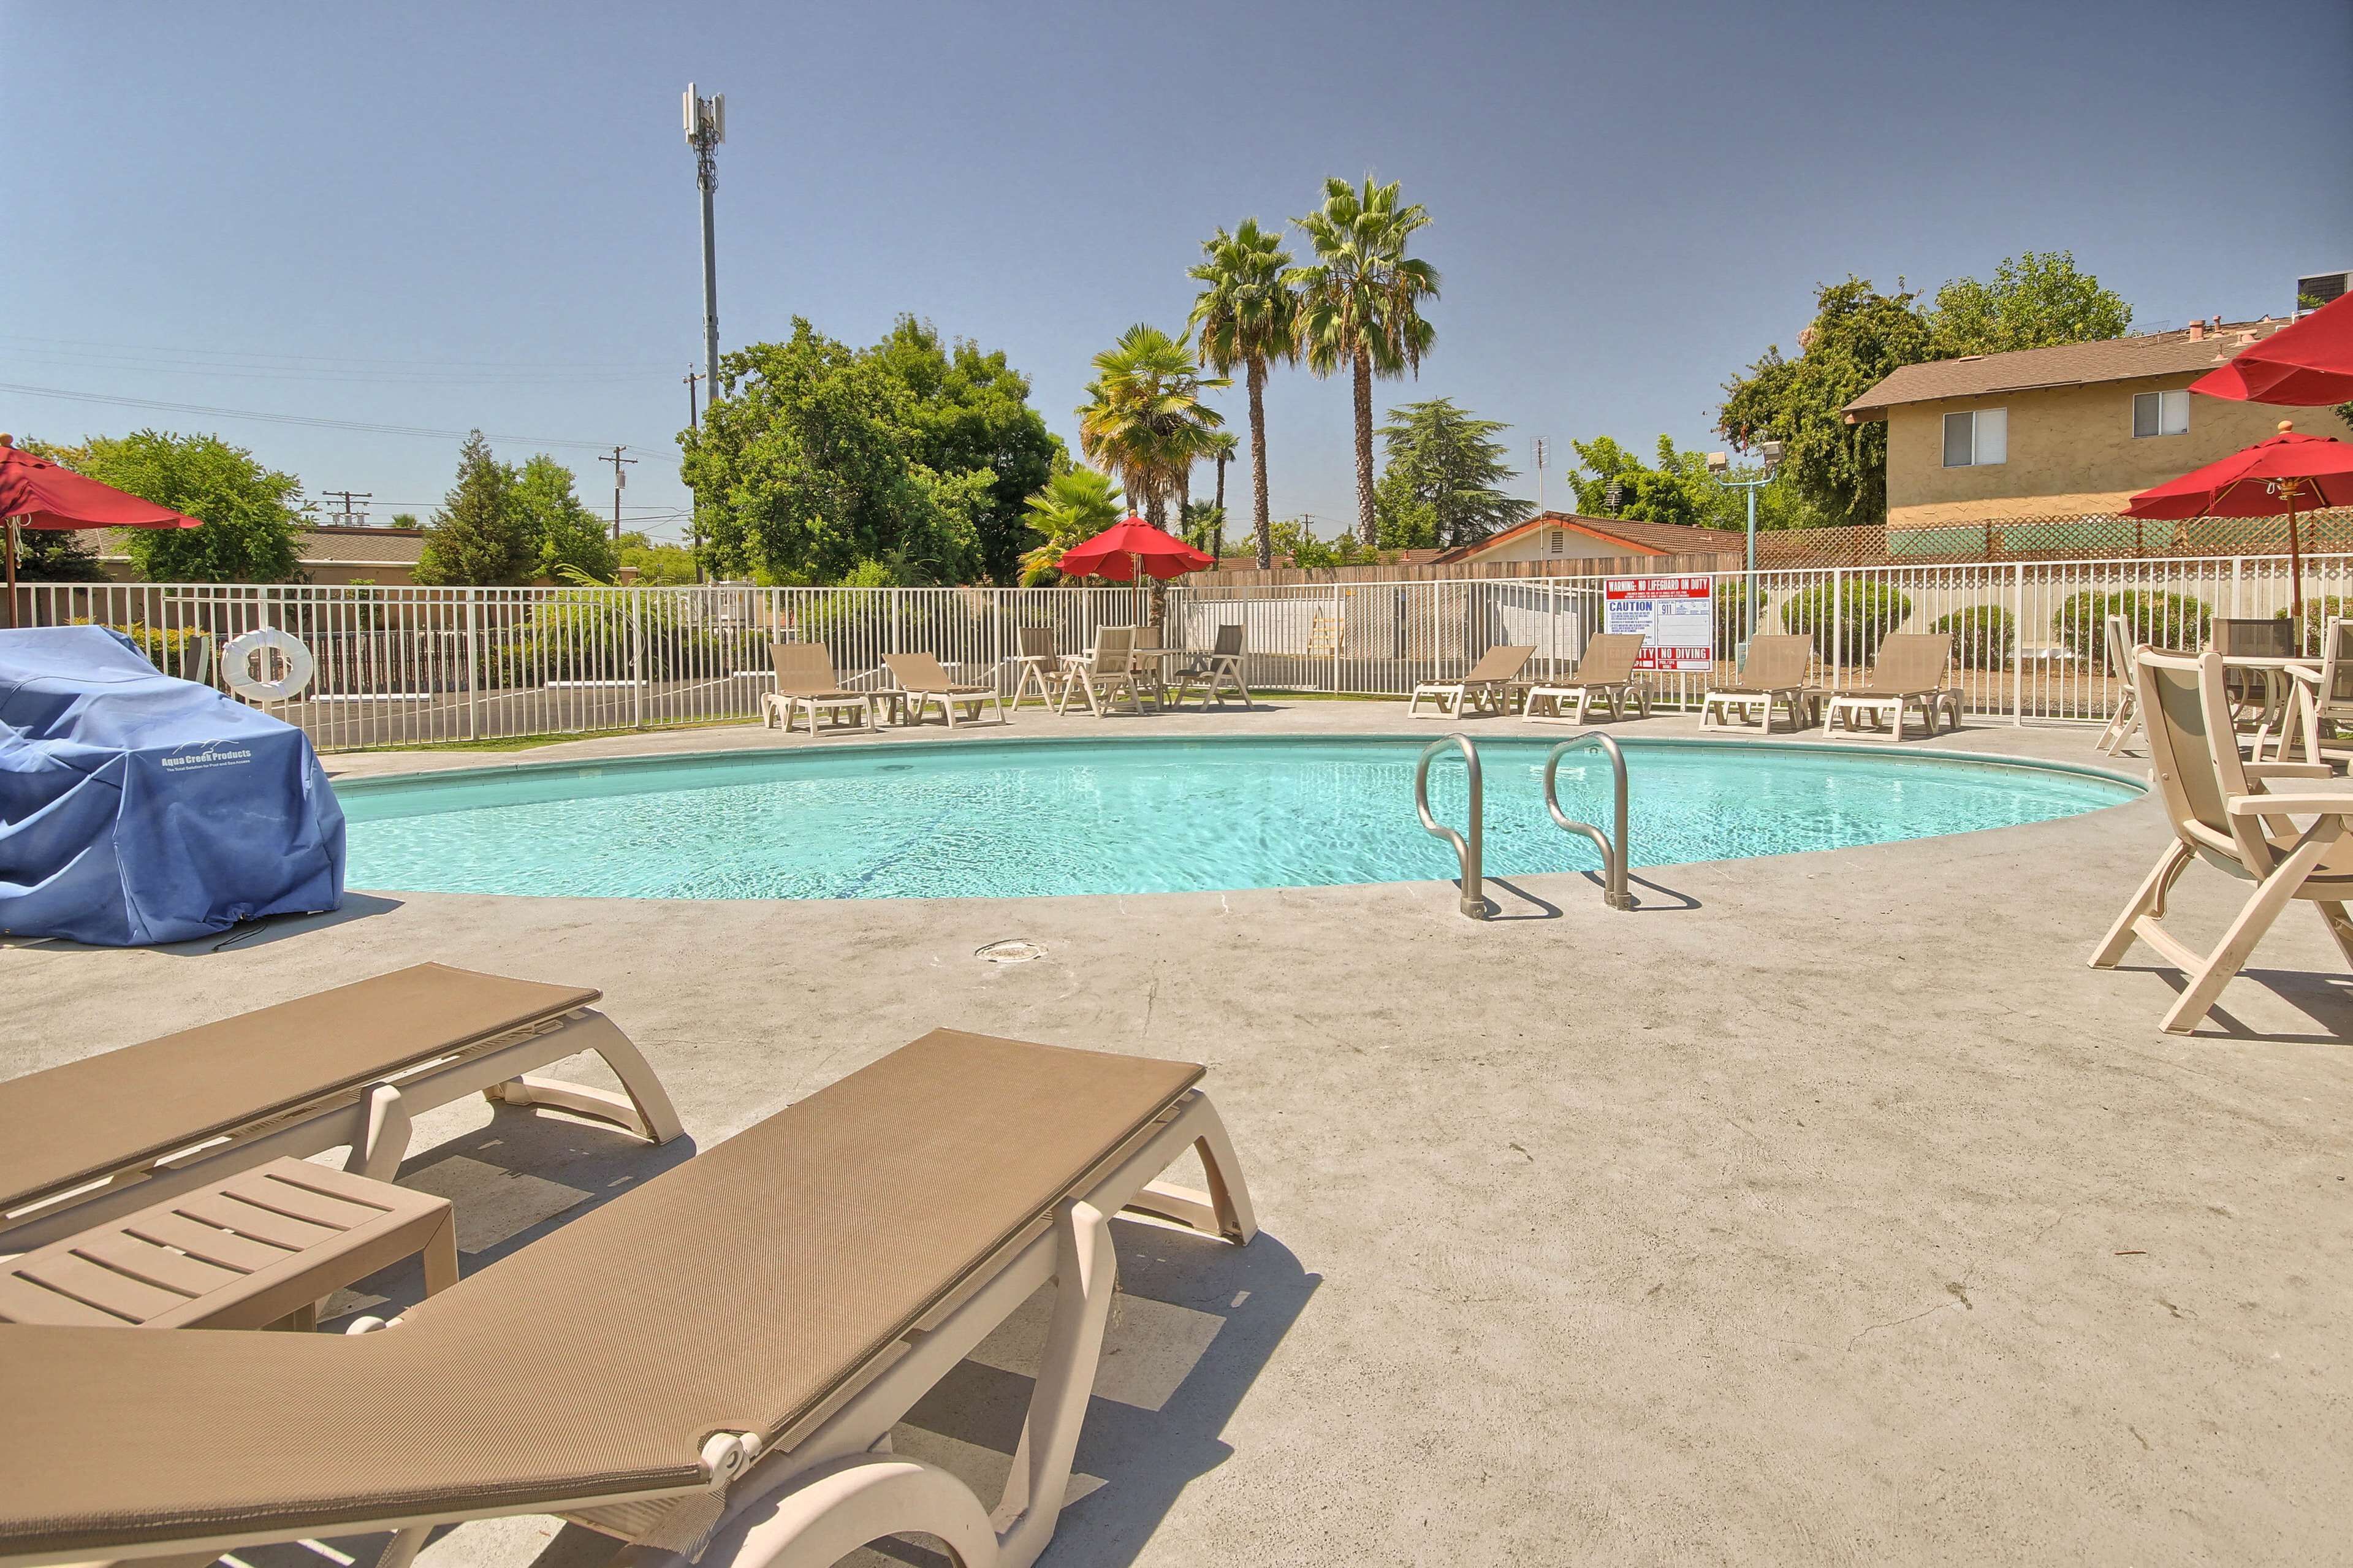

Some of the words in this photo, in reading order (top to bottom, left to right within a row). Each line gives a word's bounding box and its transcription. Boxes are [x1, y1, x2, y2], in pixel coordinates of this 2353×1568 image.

[1608, 580, 1636, 592] WARNING:
[1638, 580, 1646, 591] NO
[1648, 579, 1679, 591] LIFEGUARD
[1681, 579, 1689, 590] ON
[1691, 578, 1708, 589] DUTY
[1610, 601, 1652, 611] CAUTION
[1662, 604, 1671, 614] 911
[1660, 648, 1672, 659] NO
[1676, 648, 1706, 659] DIVING
[162, 757, 184, 767] Aqua
[185, 753, 211, 764] Creek
[213, 750, 251, 761] Products
